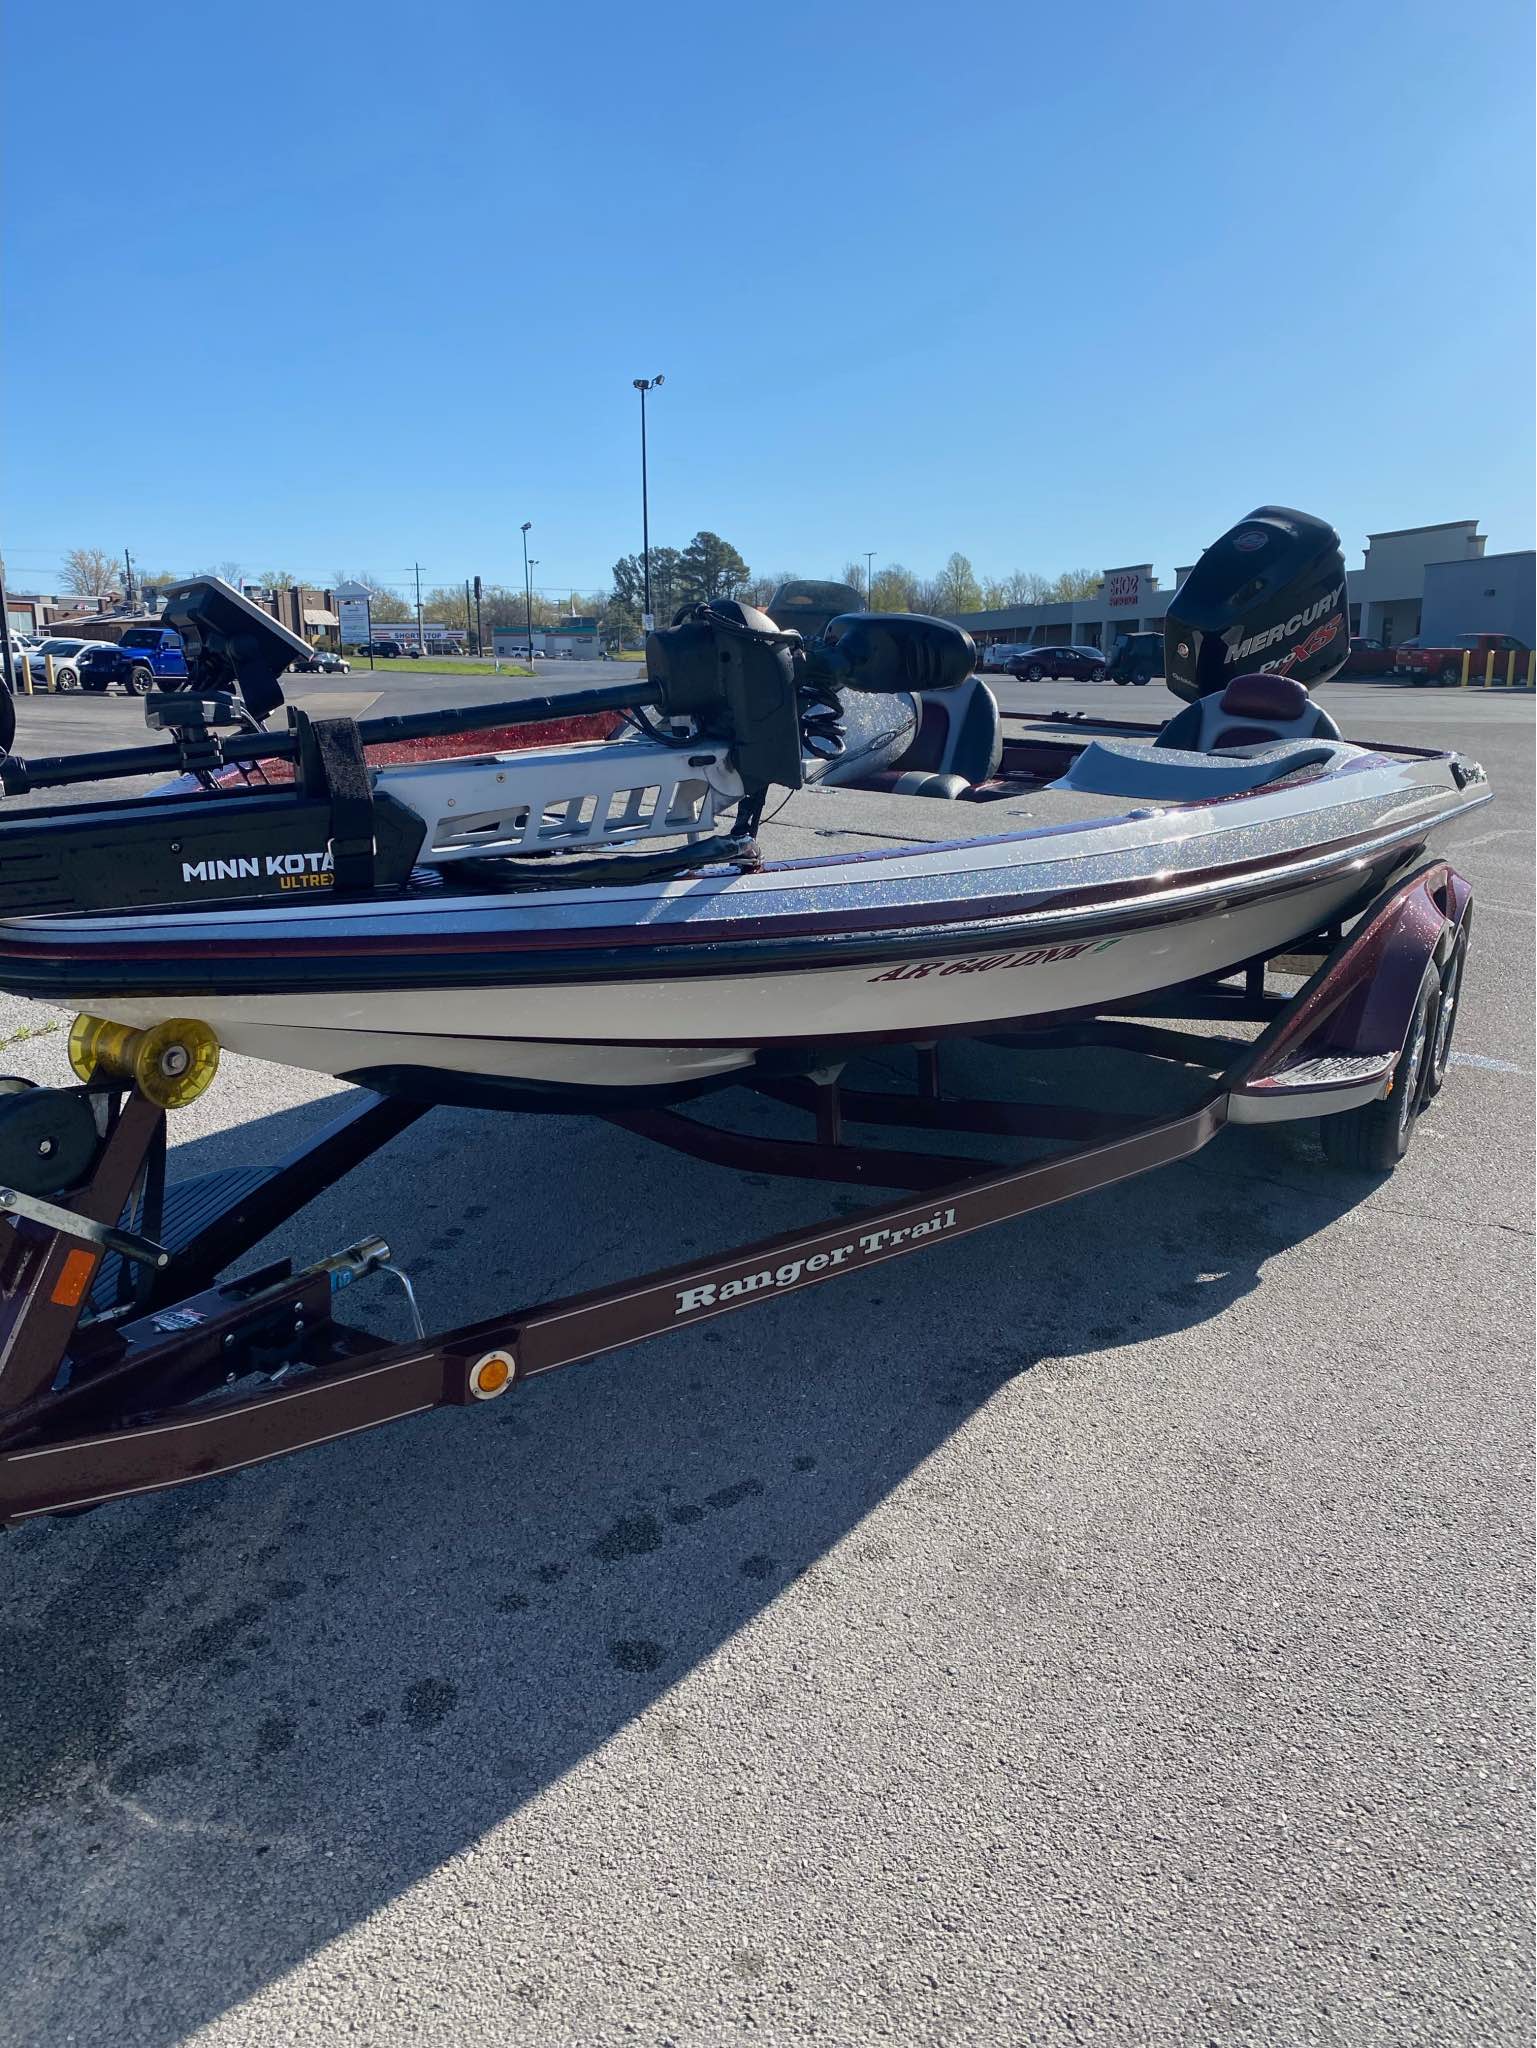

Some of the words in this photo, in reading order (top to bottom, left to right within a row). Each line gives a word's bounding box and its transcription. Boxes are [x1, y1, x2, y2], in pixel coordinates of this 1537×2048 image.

[1223, 581, 1344, 664] MERCURY
[182, 857, 260, 883] MINN
[265, 852, 335, 876] KOTA
[866, 963, 945, 983] AR
[674, 1244, 855, 1316] Ranger
[858, 1207, 957, 1255] Trail
